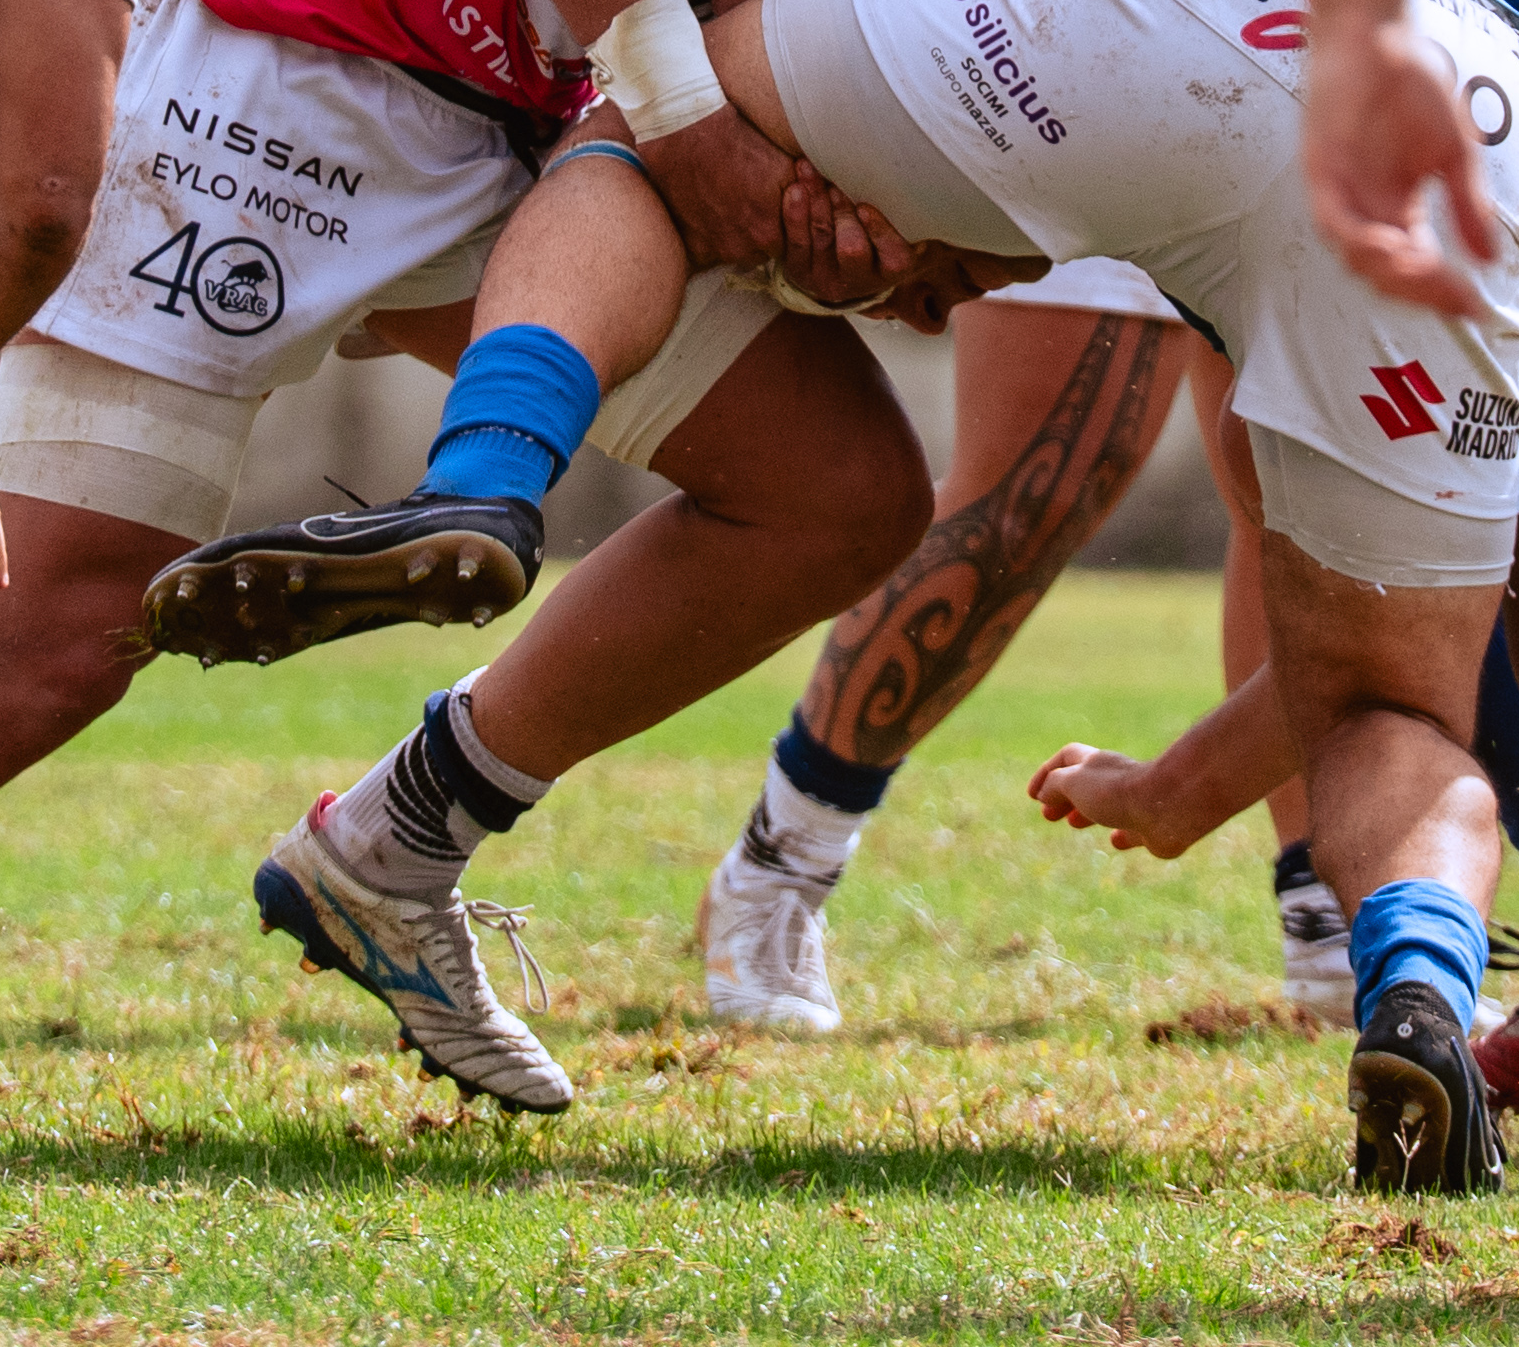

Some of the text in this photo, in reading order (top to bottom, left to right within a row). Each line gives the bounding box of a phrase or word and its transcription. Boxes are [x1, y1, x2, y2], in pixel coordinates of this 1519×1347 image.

[929, 46, 963, 94] GRUPO
[960, 56, 1010, 119] SOCIMI
[965, 3, 1068, 146] silicius
[162, 98, 364, 198] NISSAN
[151, 151, 349, 245] EYLO MOTOR
[129, 220, 286, 337] 40
[204, 278, 269, 317] VRAC
